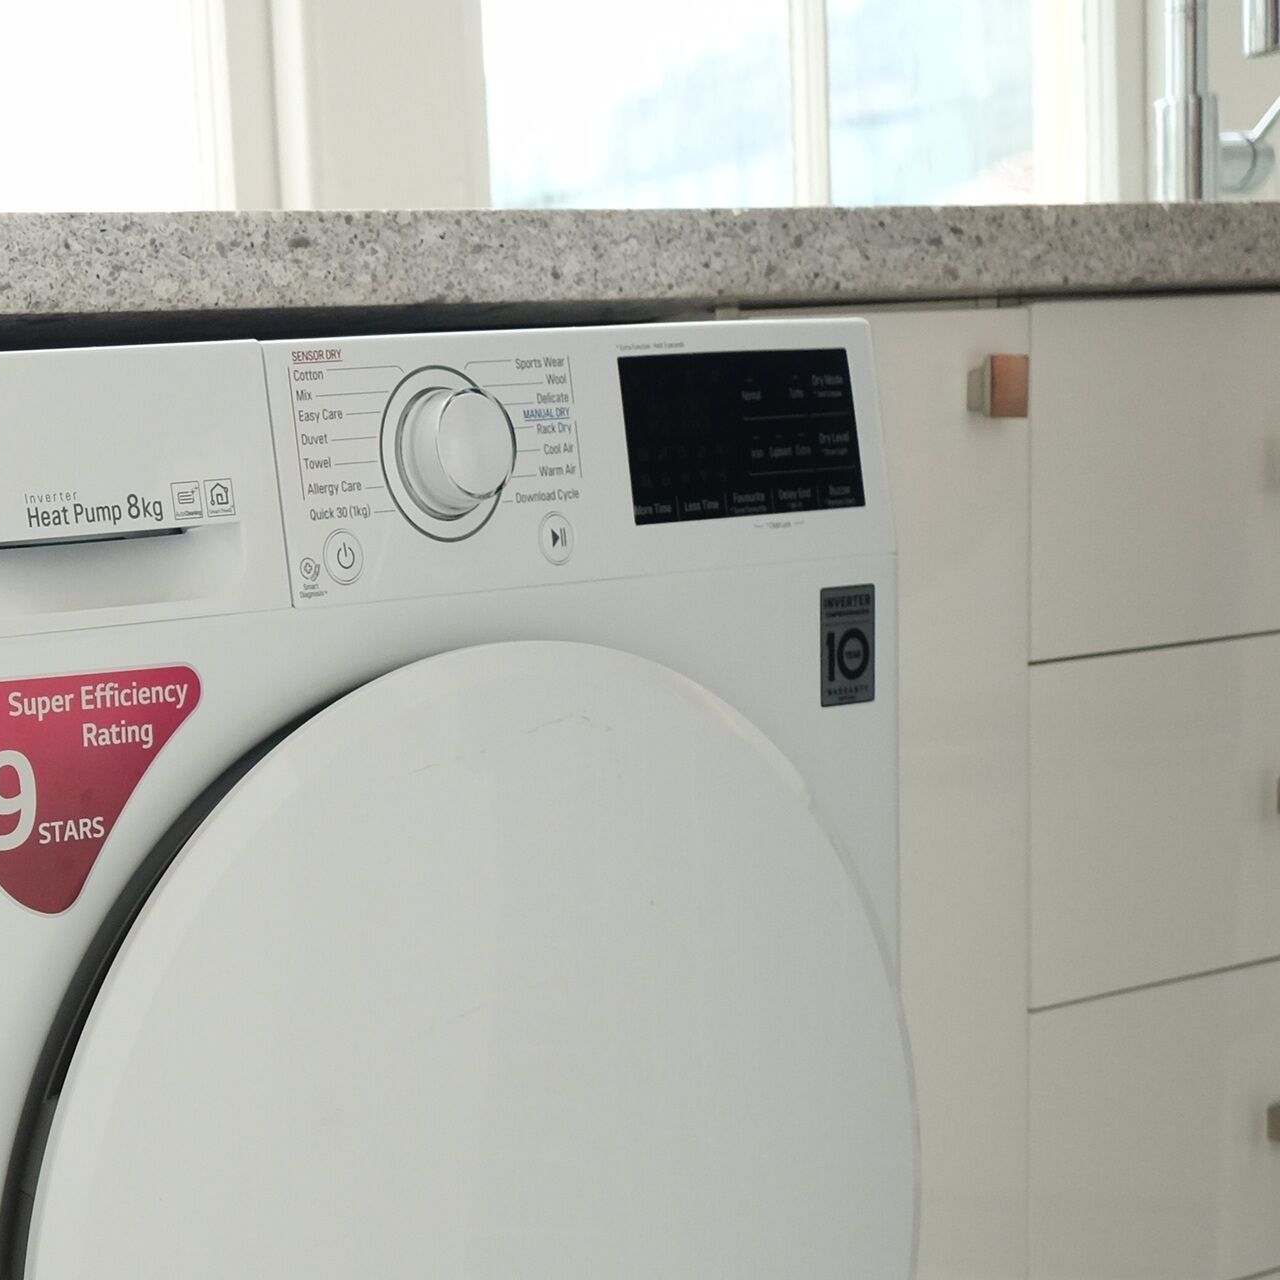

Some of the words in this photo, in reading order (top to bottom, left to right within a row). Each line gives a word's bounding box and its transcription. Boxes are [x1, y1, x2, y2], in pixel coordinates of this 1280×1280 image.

[291, 350, 324, 362] SENSOR
[325, 349, 342, 360] DRY
[515, 358, 542, 371] Sports
[543, 357, 565, 368] Wear
[293, 369, 324, 381] Cotton
[545, 374, 567, 384] Wool
[296, 389, 312, 401] Mix
[536, 392, 569, 404] Delicate
[298, 410, 320, 423] Easy
[322, 408, 343, 420] Care
[523, 408, 554, 418] MANUAL
[555, 407, 570, 417] DRY
[536, 423, 556, 435] Rack
[558, 422, 571, 434] Dry
[301, 433, 328, 446] Duvet
[543, 444, 561, 455] Cool
[563, 442, 573, 453] Air
[304, 457, 332, 470] Towel
[539, 466, 564, 477] Warm
[565, 464, 576, 475] Air
[307, 483, 339, 496] Allergy
[341, 480, 362, 492] Care
[24, 491, 77, 505] Inverter
[515, 490, 556, 503] Download
[557, 488, 579, 501] Cycle
[27, 506, 68, 528] Heat
[73, 503, 122, 525] Pump
[310, 508, 335, 520] Quick
[336, 507, 347, 519] 30
[349, 503, 371, 518] (1kg)
[823, 593, 871, 609] INVERTER
[826, 627, 869, 682] 10
[8, 691, 74, 721] Super
[80, 682, 188, 710] Efficiency
[82, 720, 153, 749] Rating
[39, 816, 105, 844] STARS
